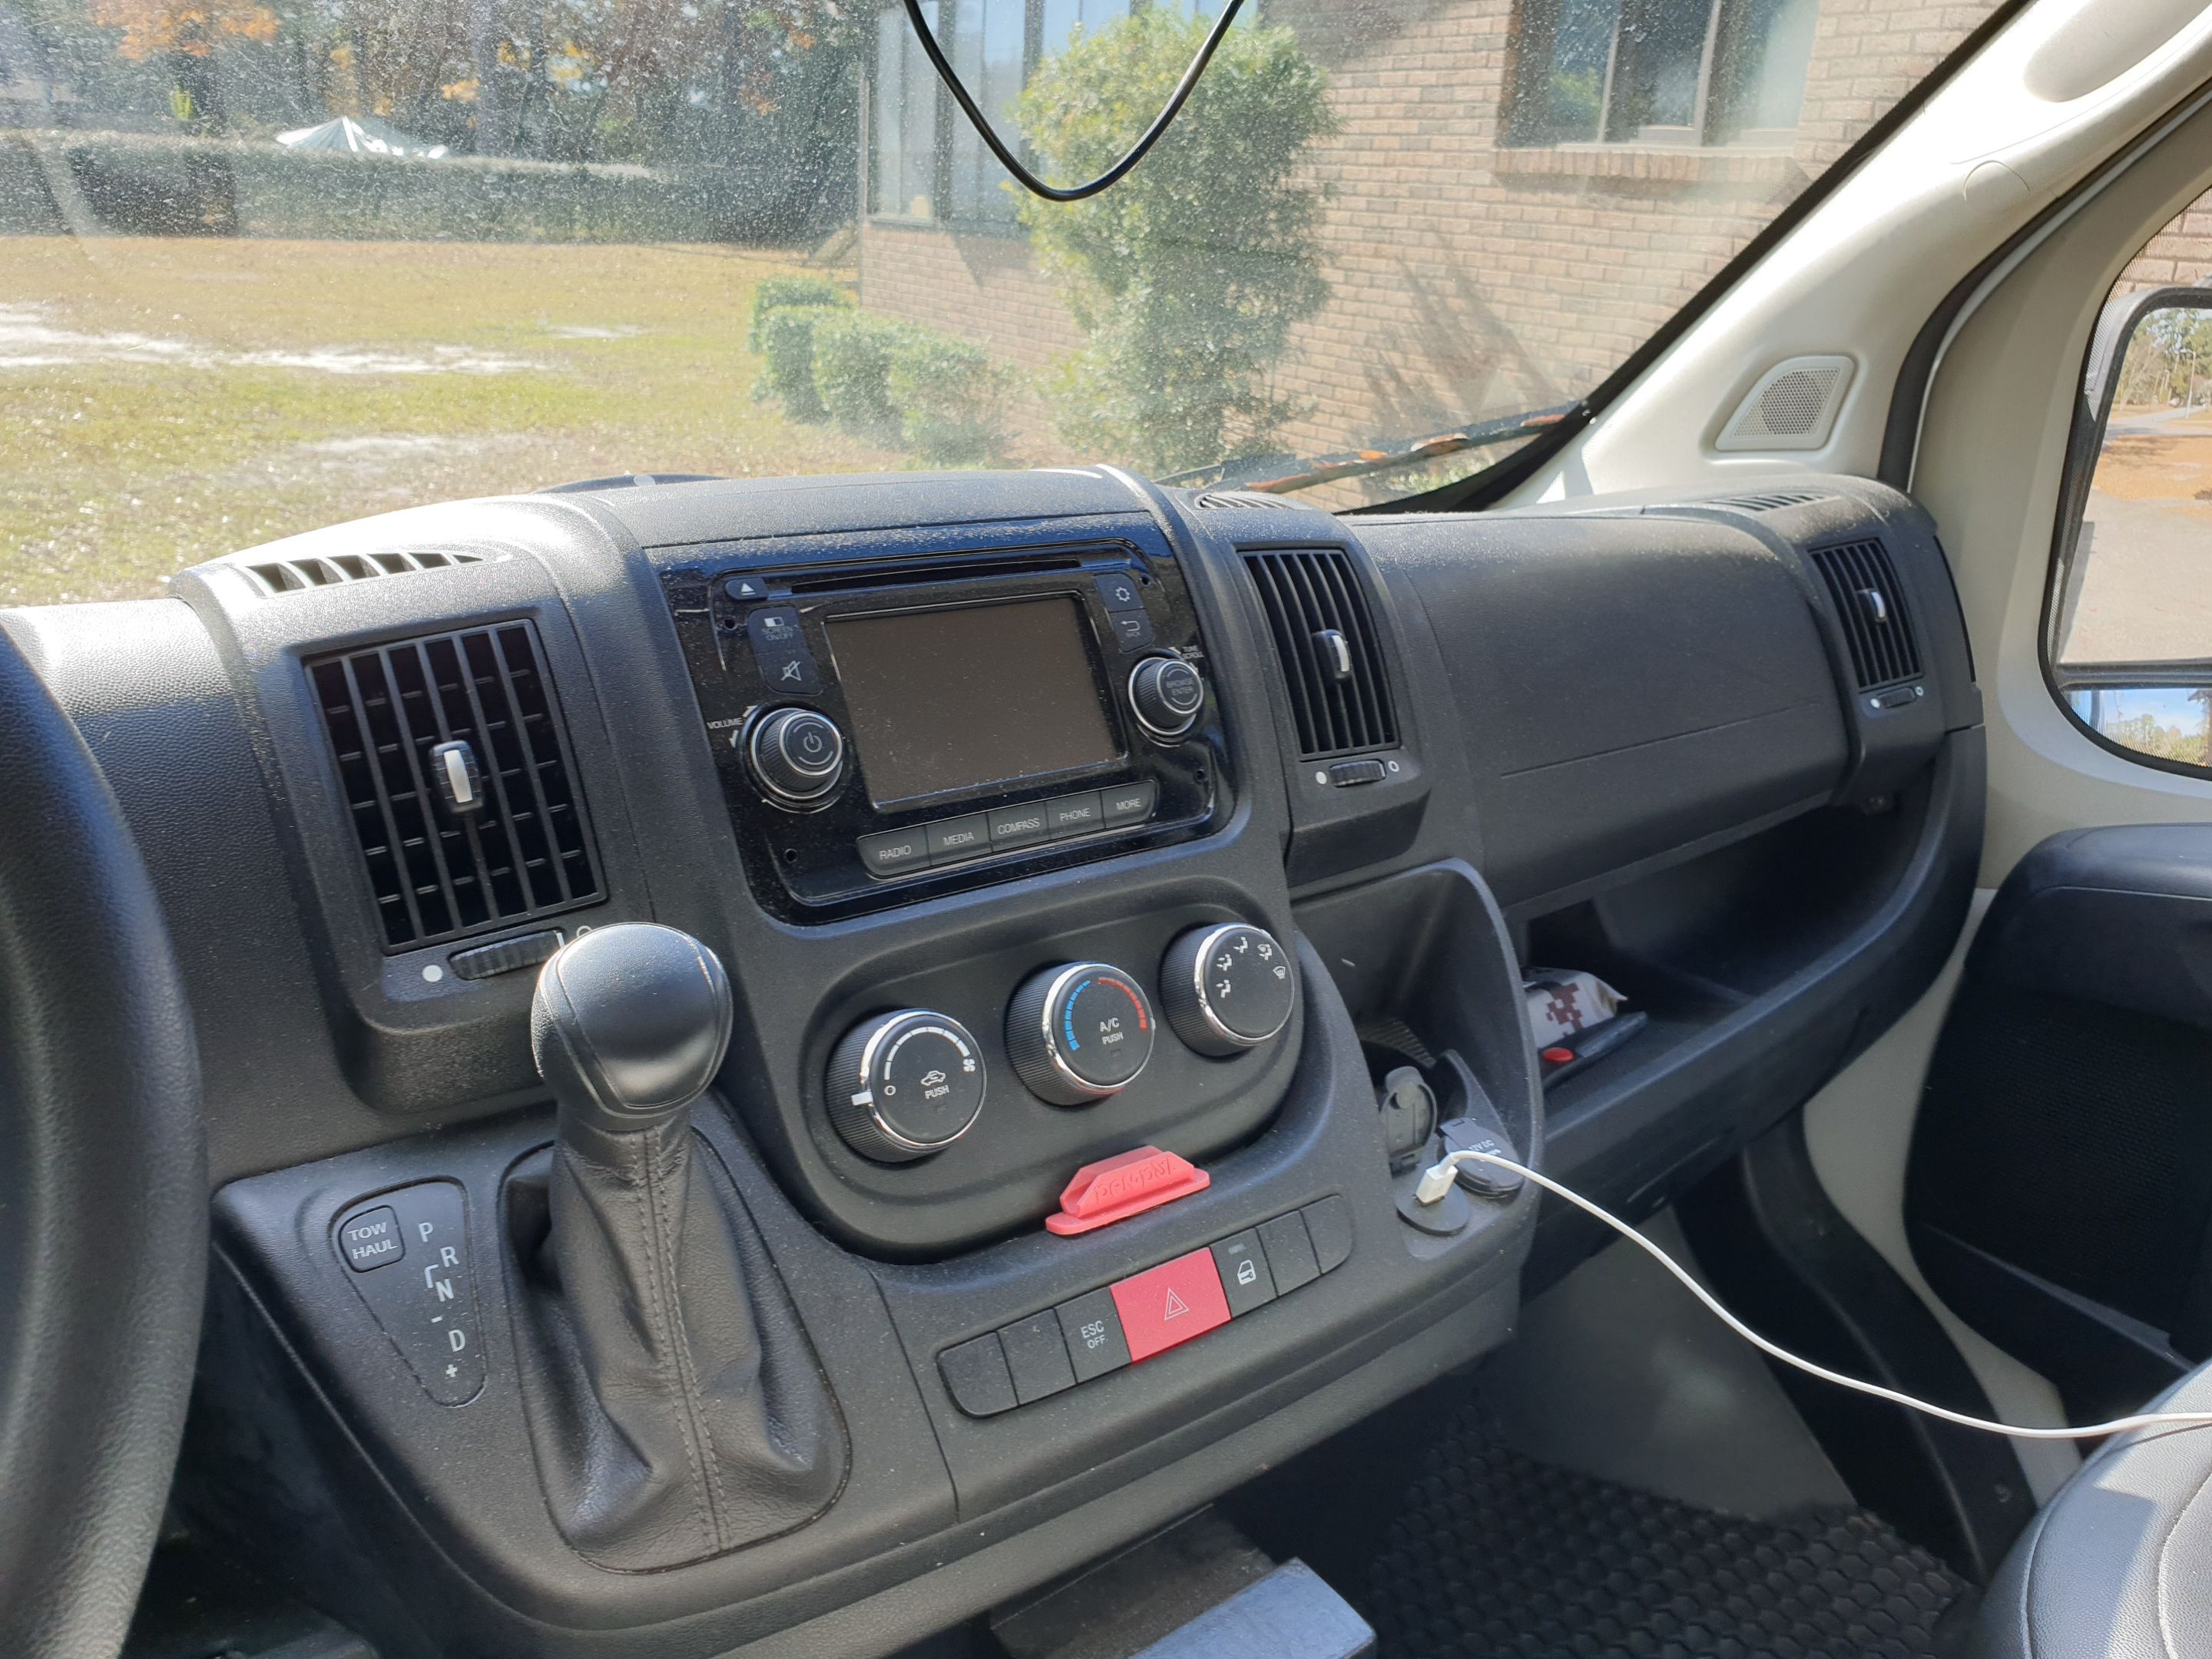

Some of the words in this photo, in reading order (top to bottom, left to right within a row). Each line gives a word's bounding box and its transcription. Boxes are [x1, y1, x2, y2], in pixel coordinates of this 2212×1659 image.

[1167, 677, 1194, 688] BROWSE
[1171, 687, 1194, 696] ENTER
[707, 717, 743, 730] VOLUME
[1115, 798, 1141, 811] MORE
[1059, 808, 1091, 822] PHONE
[998, 818, 1041, 835] COMPASS
[943, 832, 974, 846] MEDIA
[879, 845, 912, 860] RADIO
[1100, 1018, 1120, 1032] A/C
[1101, 1031, 1124, 1045] PUSH
[925, 1084, 950, 1099] PUSH
[347, 1222, 387, 1241] TOW
[418, 1222, 434, 1242] P
[352, 1239, 398, 1260] HAUL
[440, 1246, 459, 1267] R
[435, 1278, 455, 1302] N
[1081, 1320, 1104, 1339] ESC
[449, 1329, 466, 1353] D
[1087, 1335, 1105, 1349] OFF
